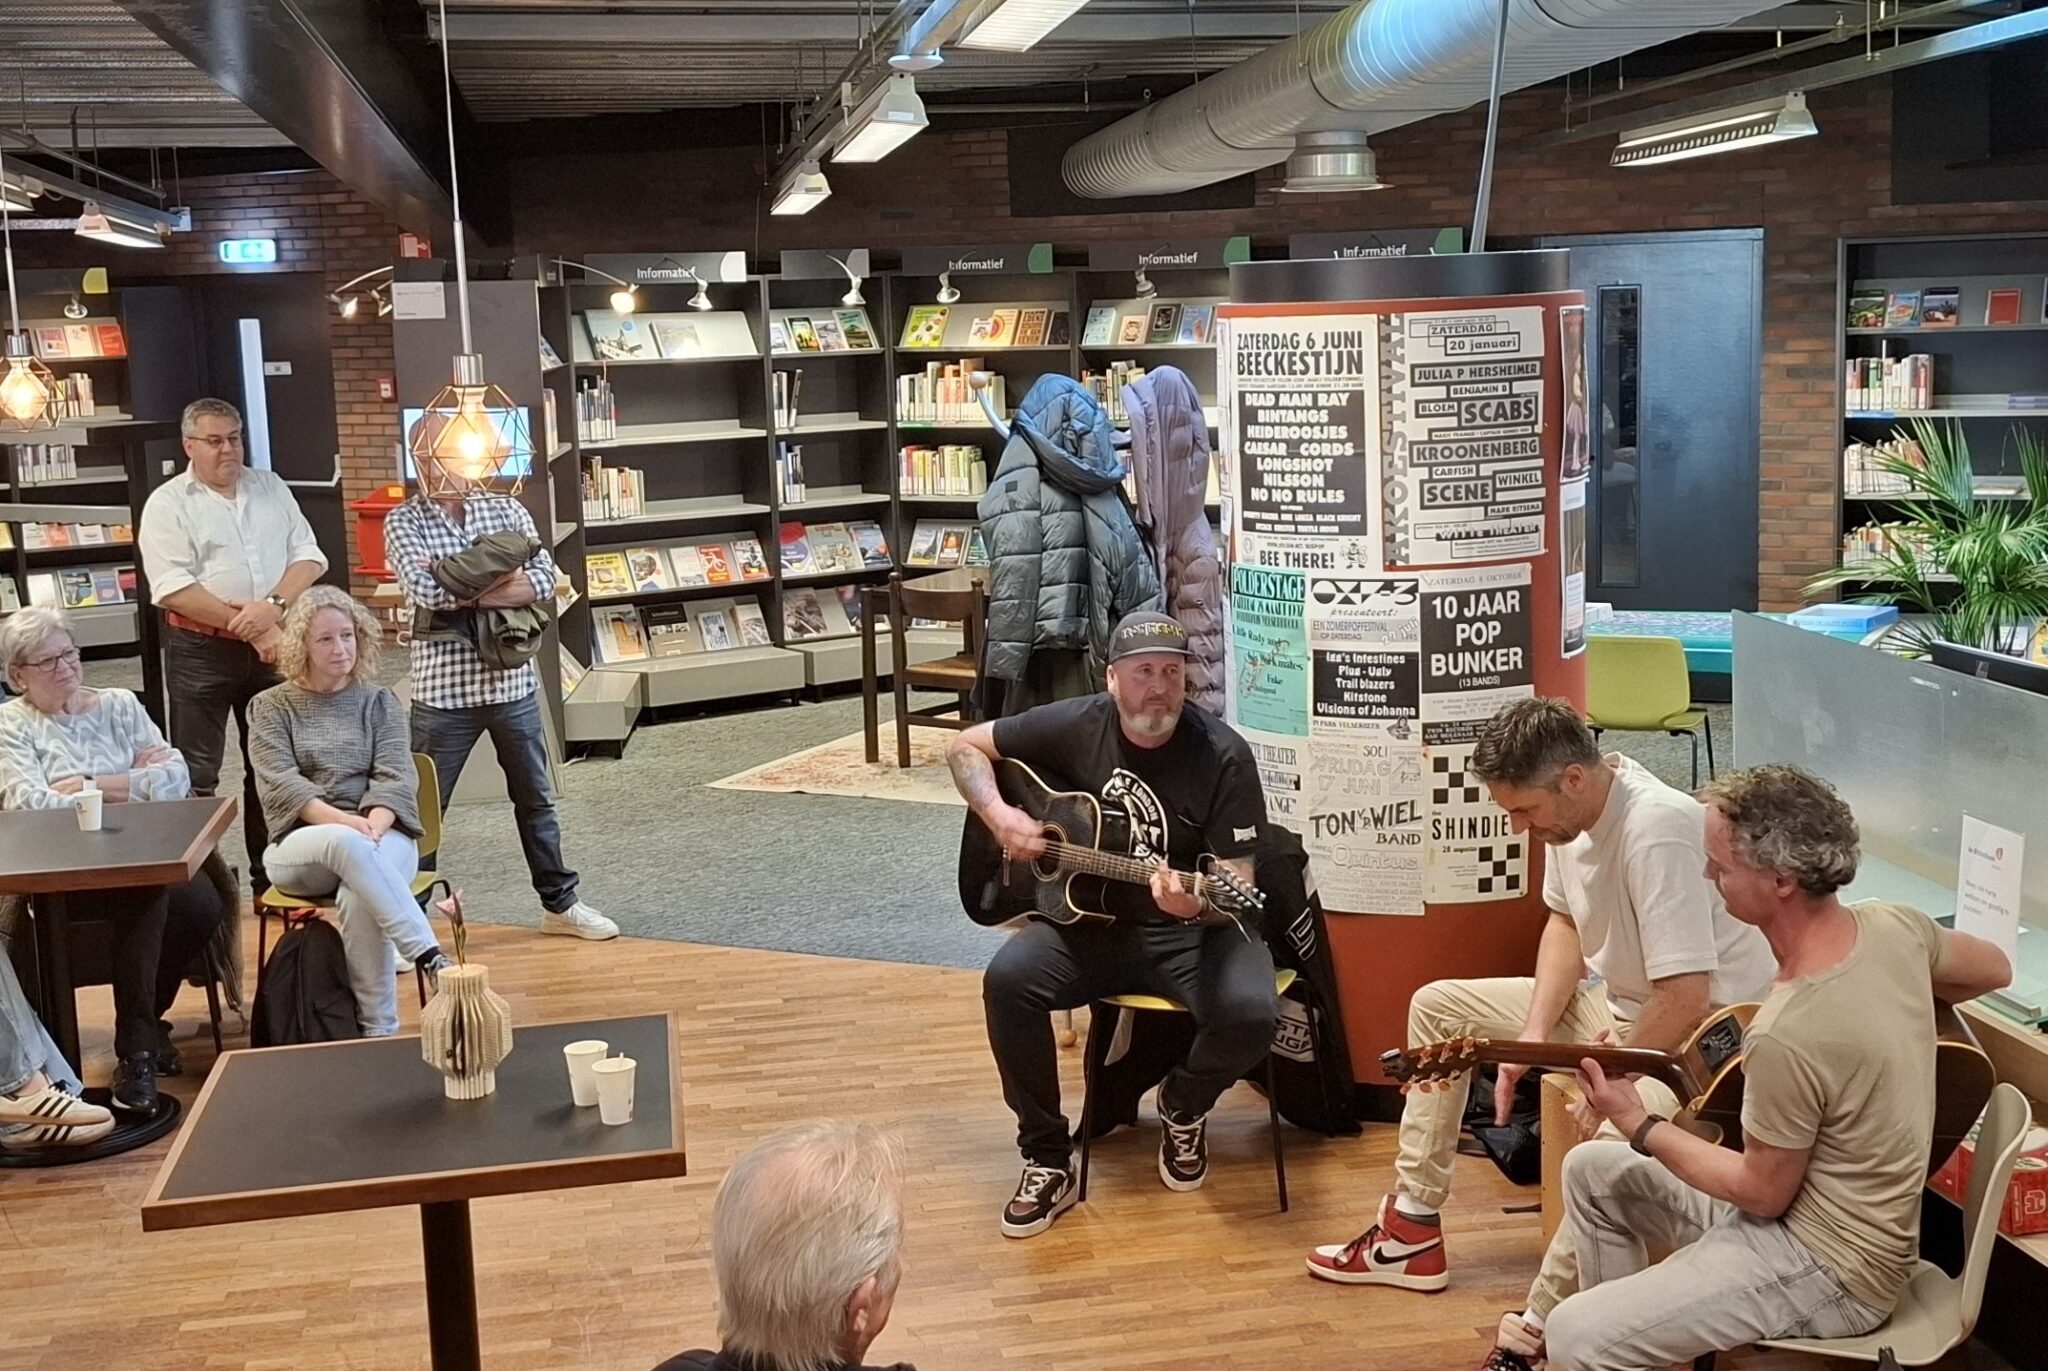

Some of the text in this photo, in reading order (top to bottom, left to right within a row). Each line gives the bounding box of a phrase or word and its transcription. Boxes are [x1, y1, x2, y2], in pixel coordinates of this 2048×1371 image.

[949, 258, 1004, 270] Informatief
[1138, 252, 1198, 265] Informatief
[637, 266, 696, 279] Informatief
[1431, 324, 1493, 335] ZATERDAG
[1237, 330, 1362, 350] ZATERDAG 6 JUNI
[1449, 337, 1516, 352] 20 januari
[1237, 350, 1363, 376] BEECKESTIJN
[1418, 363, 1537, 381] JULIA P HERSHEIMER
[1453, 385, 1499, 396] BENJAMIN
[1245, 392, 1350, 406] DEAD MAN RAY
[1421, 403, 1456, 413] BLOEM
[1464, 398, 1534, 424] SCABS
[1257, 409, 1329, 423] BINTANGS
[1247, 425, 1348, 440] HEIDEROOSJES
[1244, 441, 1354, 456] CAESAR CORDS
[1416, 439, 1537, 462] KROONENBERG
[1256, 457, 1334, 472] LONGSHOT
[1263, 473, 1325, 487] NILSSON
[1498, 472, 1540, 487] WINKEL
[1250, 487, 1346, 503] NO NO RULES
[1426, 482, 1490, 504] SCENE
[1259, 550, 1335, 569] BEE THERE!
[1431, 590, 1520, 620] 10 JAAR
[1456, 620, 1501, 647] POP
[1430, 646, 1523, 677] BUNKER
[1368, 666, 1392, 677] Ugly
[1472, 675, 1500, 687] BANDS)
[1317, 702, 1416, 717] Visions of Johanna
[1262, 745, 1297, 765] THEATER
[1363, 745, 1388, 757] SOLI
[1342, 778, 1381, 795] JUNI
[1309, 810, 1356, 839] TON
[1370, 799, 1422, 830] WIEL
[1376, 832, 1421, 845] BAND
